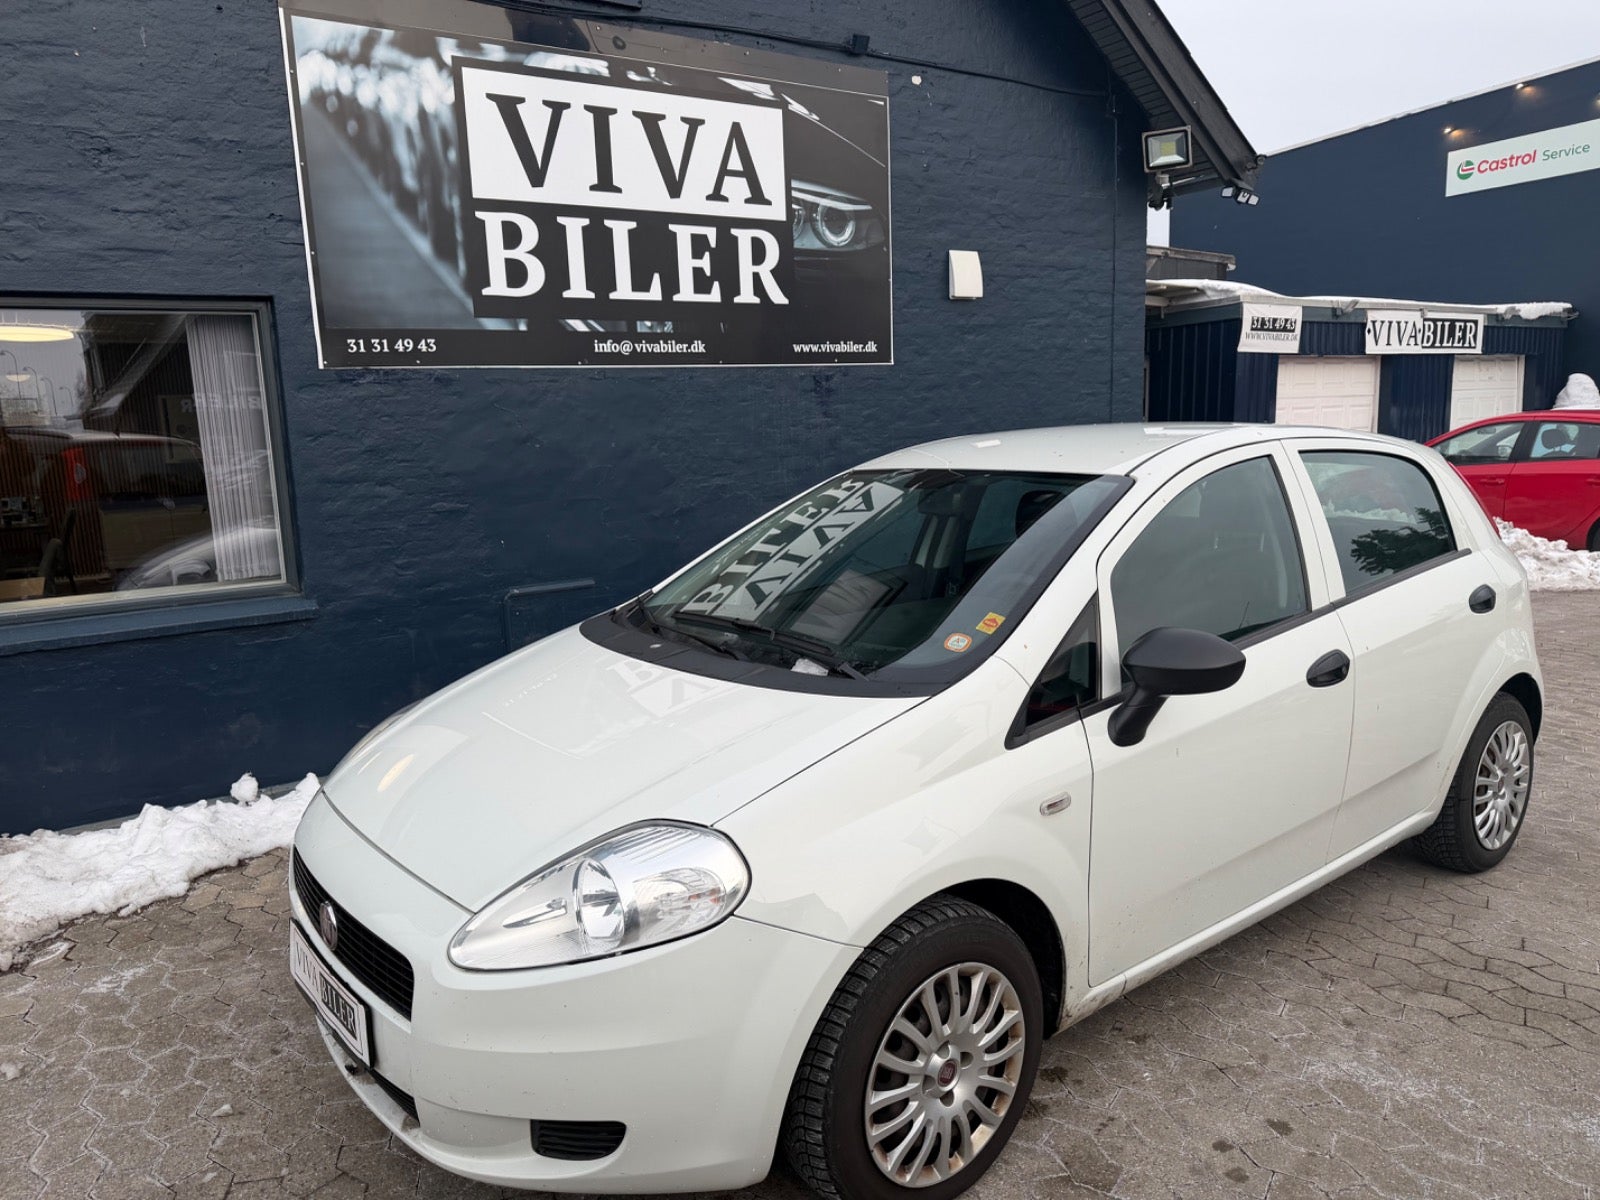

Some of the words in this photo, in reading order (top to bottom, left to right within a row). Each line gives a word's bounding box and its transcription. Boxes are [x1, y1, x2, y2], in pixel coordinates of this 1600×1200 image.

[485, 92, 773, 206] VIVA
[1477, 149, 1537, 174] Castrol
[1542, 143, 1590, 162] Service
[474, 210, 790, 305] BILER
[1252, 316, 1261, 329] 31
[1263, 317, 1273, 329] 31
[1274, 317, 1285, 330] 49
[1370, 319, 1420, 346] VIVA
[1422, 320, 1476, 348] BILER
[346, 338, 366, 353] 31
[371, 338, 390, 353] 31
[394, 338, 414, 353] 49
[417, 338, 437, 353] 43
[594, 339, 706, 355] info@vivabiler.dk
[792, 340, 878, 353] www.vivabiler.dk
[295, 942, 319, 993] VIVA
[320, 976, 357, 1036] BILER
